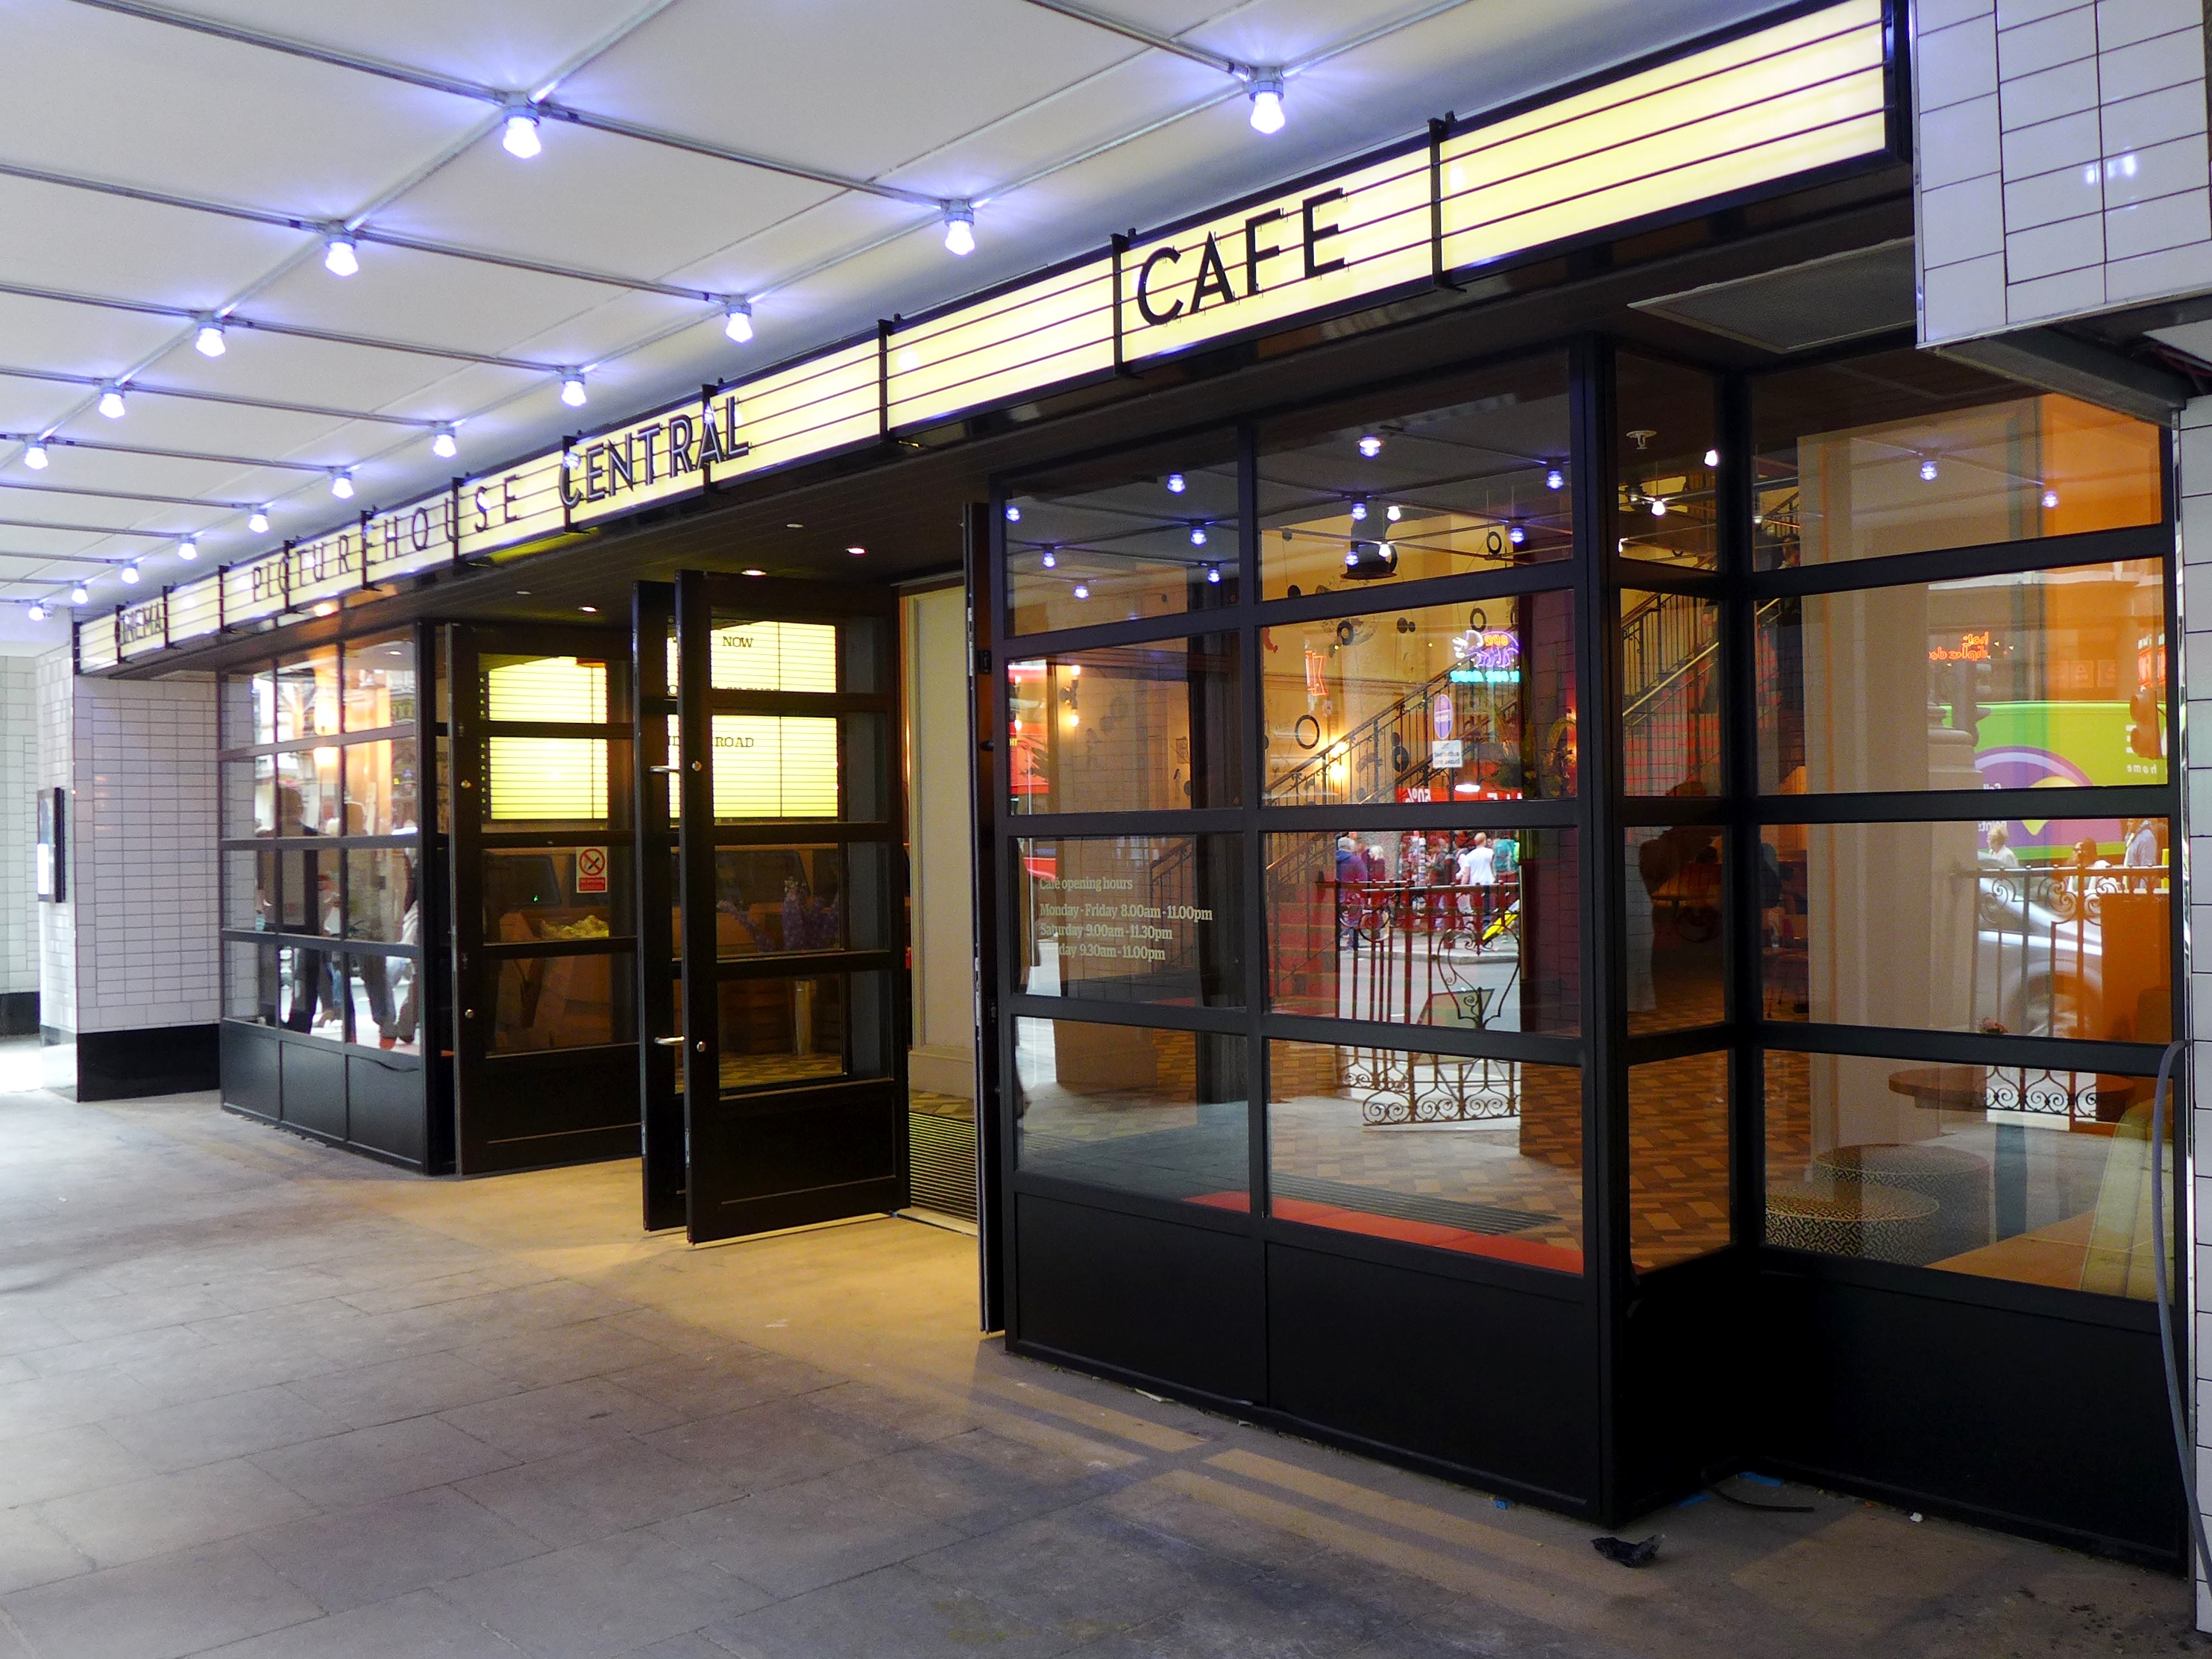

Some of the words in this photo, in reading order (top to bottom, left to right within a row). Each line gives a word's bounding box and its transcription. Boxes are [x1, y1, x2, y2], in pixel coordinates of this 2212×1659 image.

[1137, 186, 1345, 326] CAFE
[558, 395, 750, 509] CENTRAL
[722, 636, 754, 648] NOW
[714, 736, 755, 748] ROAD
[1061, 876, 1102, 892] opening
[1102, 876, 1133, 890] hours
[1040, 903, 1079, 918] Monday
[1084, 903, 1118, 920] Friday
[1120, 903, 1161, 918] 8.00am
[1166, 905, 1213, 923] 11.00pm
[1040, 923, 1083, 939] Saturday
[1122, 944, 1166, 962] 11.00pm
